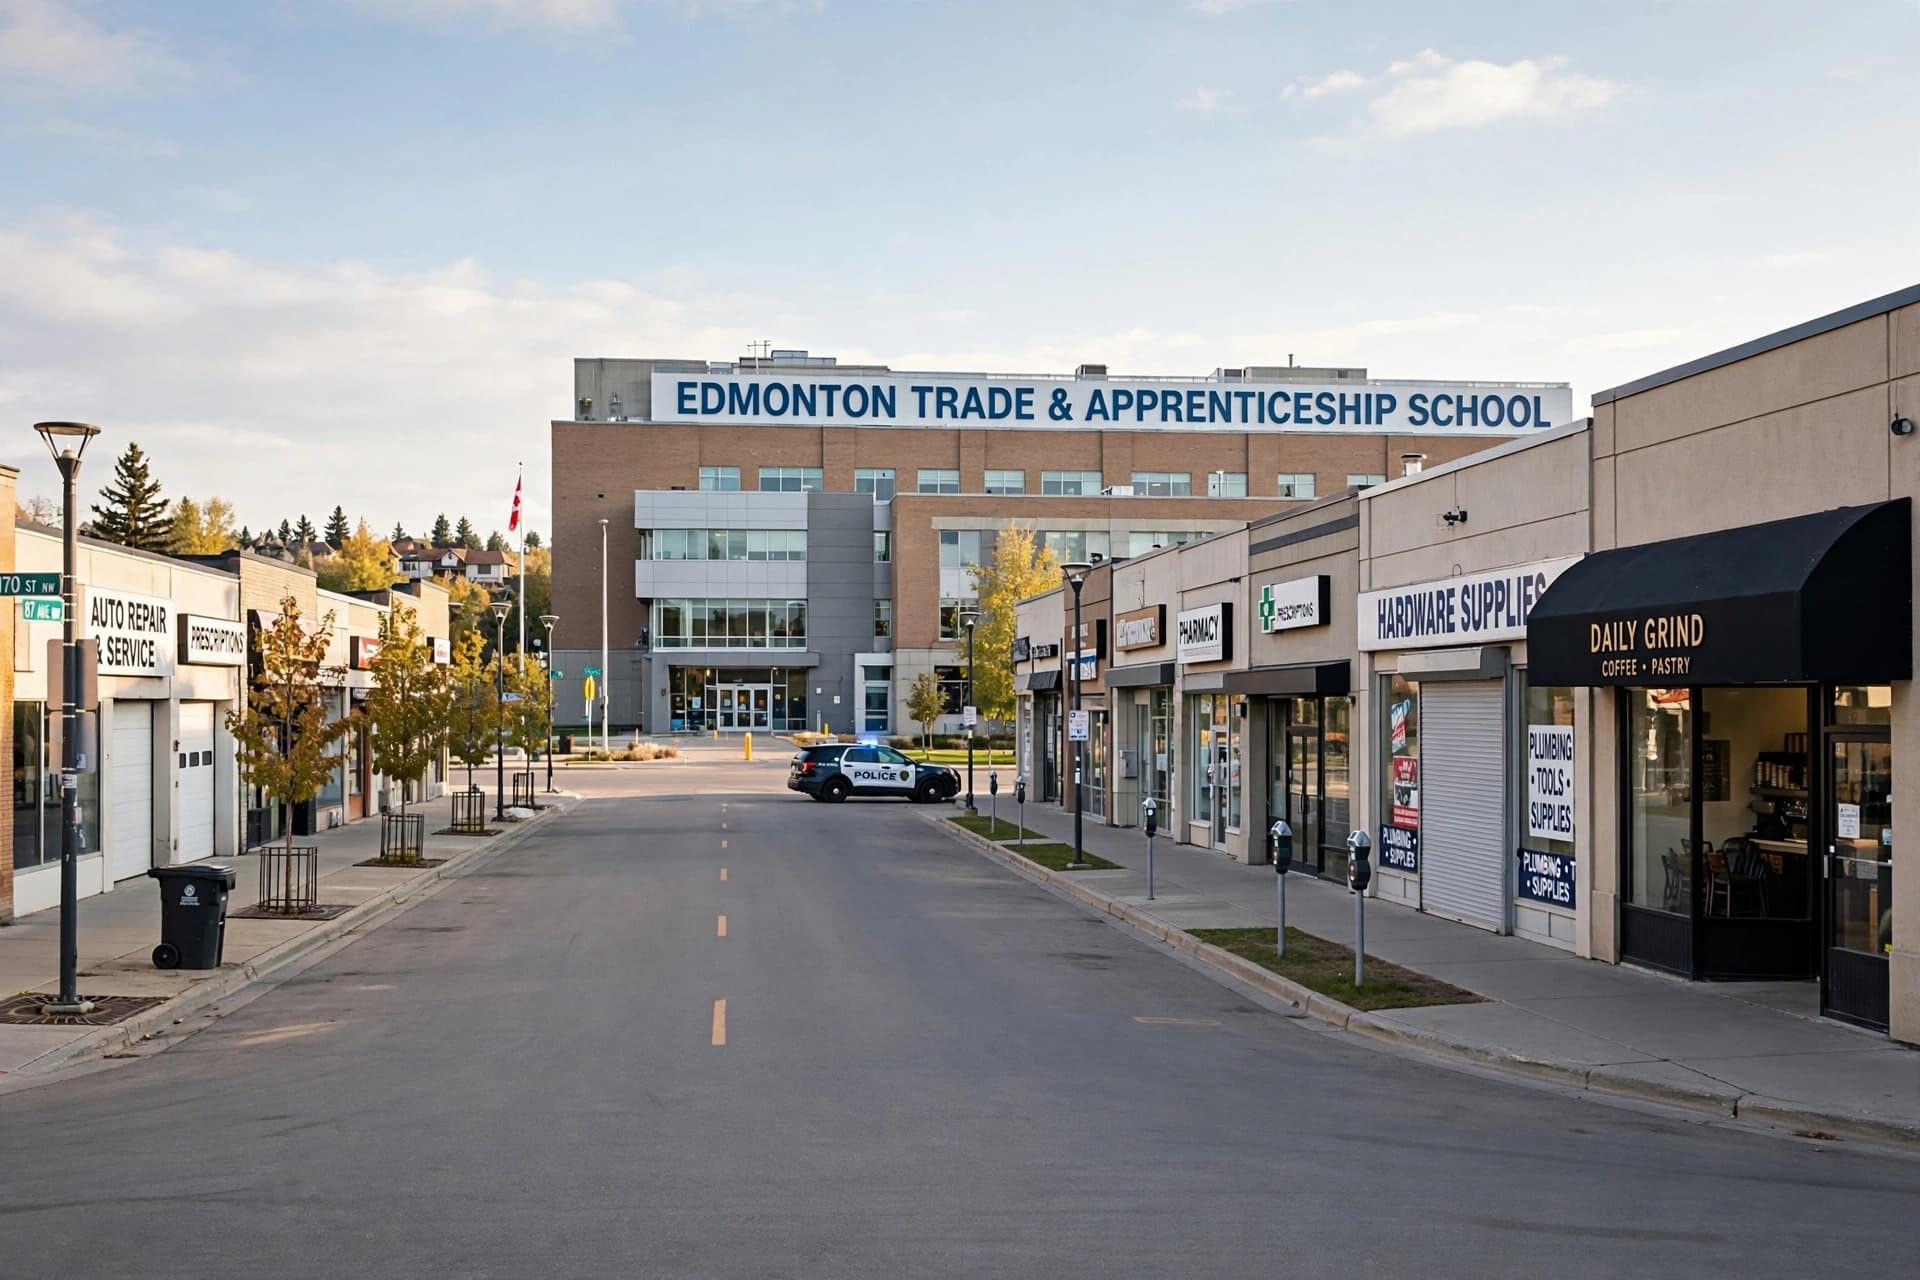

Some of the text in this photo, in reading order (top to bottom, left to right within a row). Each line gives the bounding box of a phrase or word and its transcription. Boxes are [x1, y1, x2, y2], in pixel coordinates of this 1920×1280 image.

[676, 381, 1552, 428] EDMONTON TRADE & APPRENTICESHIP SCHOOL
[25, 580, 37, 593] ST
[42, 582, 56, 593] NW
[24, 601, 36, 618] 87
[91, 597, 167, 634] AUTO REPAIR
[1378, 588, 1456, 639] HARDWARE
[191, 626, 245, 654] PRESCRIPTIONS
[1179, 615, 1218, 645] PHARMACY
[1590, 614, 1704, 653] DAILY GRIND
[107, 635, 155, 668] SERVICE
[1602, 657, 1690, 677] COFFEE PASTRY
[1529, 732, 1572, 760] PLUMBING
[854, 771, 897, 781] POLICE
[1536, 767, 1564, 796] TOOLS
[1531, 801, 1571, 833] SUPPLIES
[1532, 876, 1570, 903] SUPPLIES
